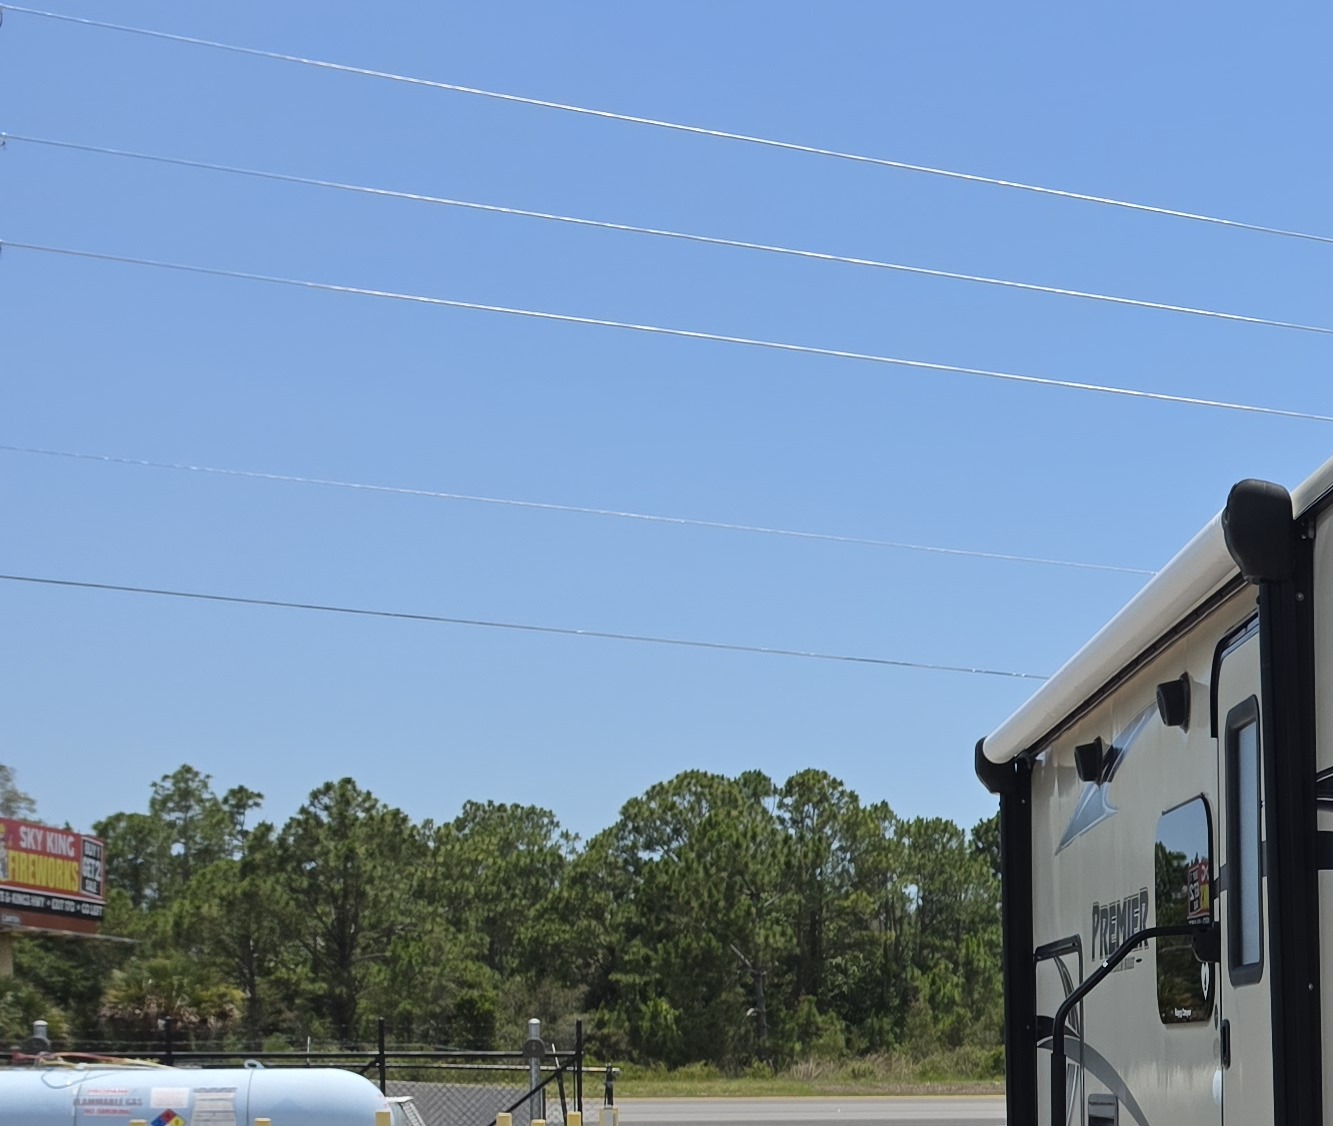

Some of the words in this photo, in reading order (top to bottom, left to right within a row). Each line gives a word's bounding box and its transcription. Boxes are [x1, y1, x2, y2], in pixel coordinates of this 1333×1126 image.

[20, 825, 43, 851] SKY
[46, 831, 76, 858] KING
[8, 849, 79, 892] FIREWORKS
[1091, 887, 1149, 962] PREMIER
